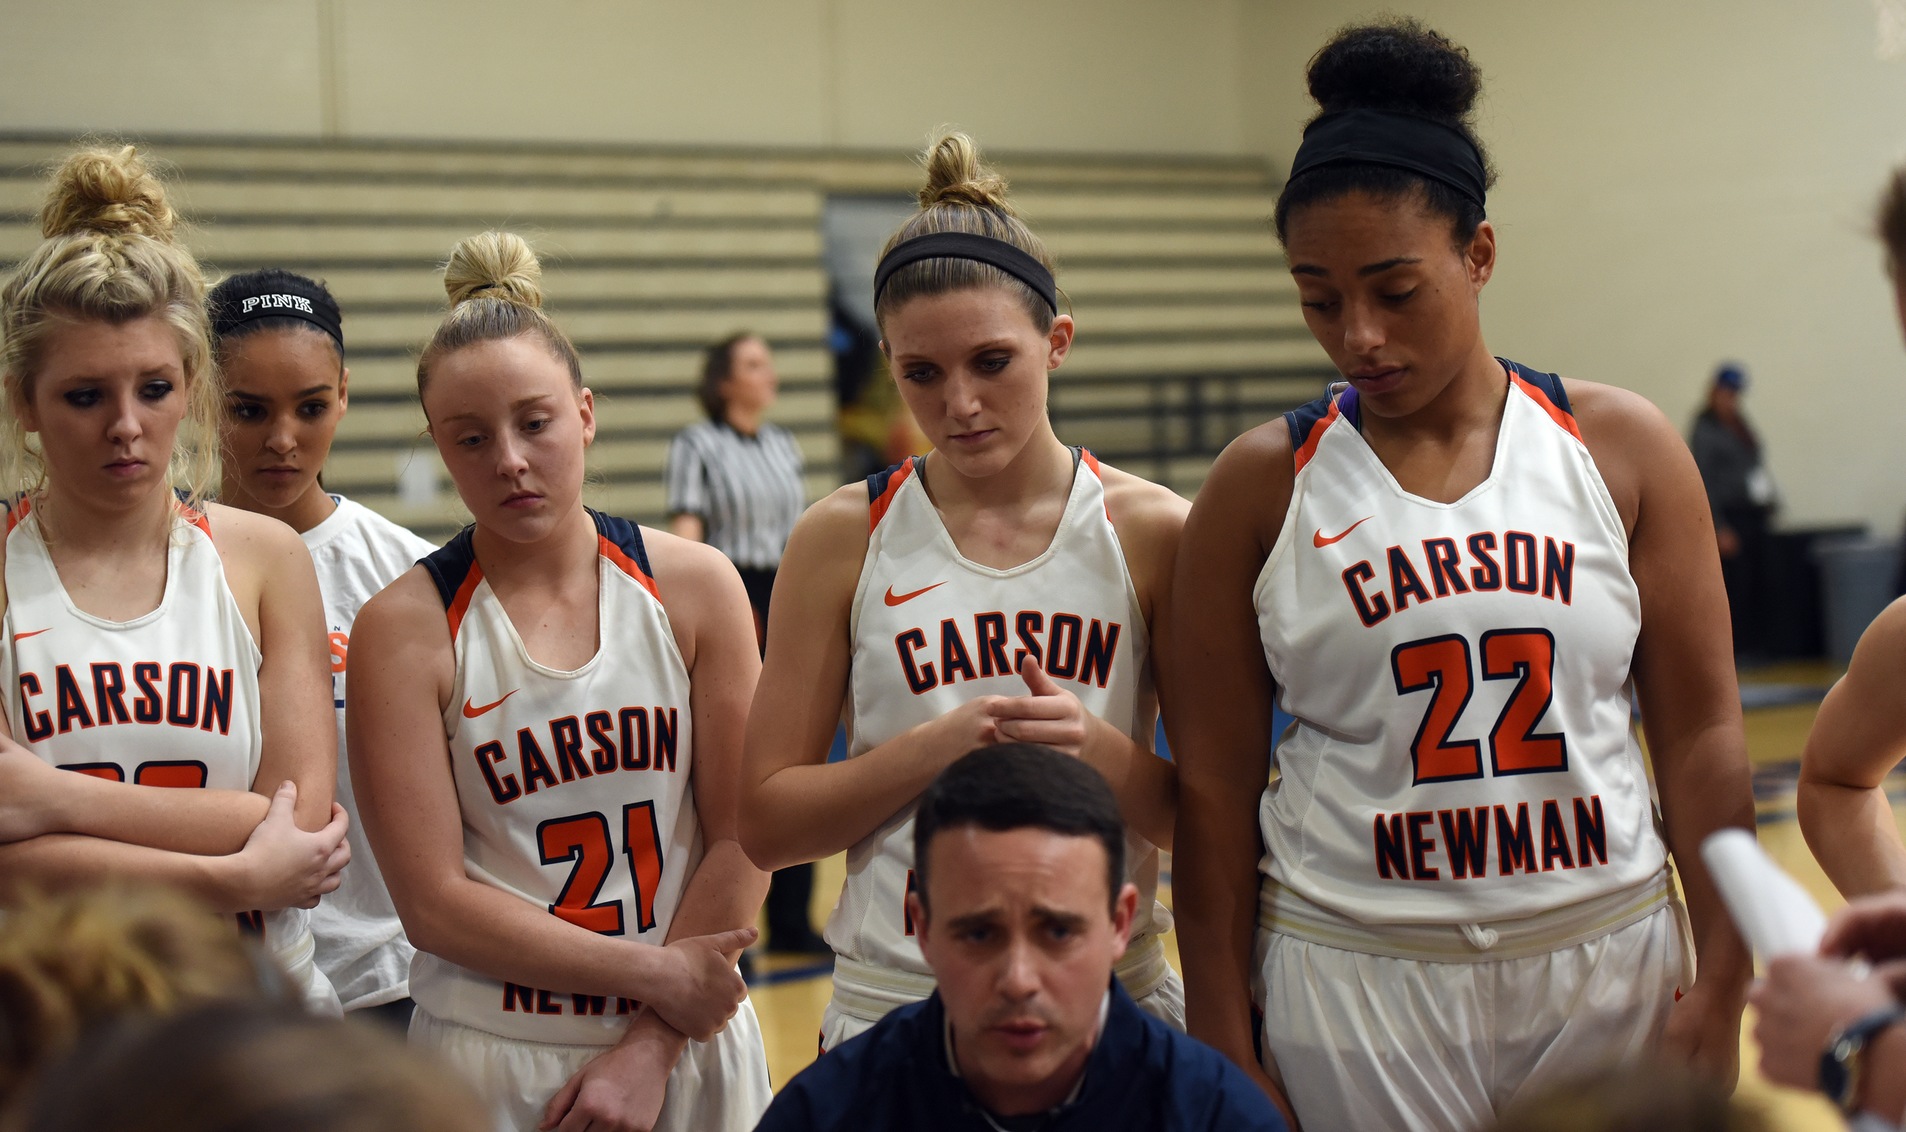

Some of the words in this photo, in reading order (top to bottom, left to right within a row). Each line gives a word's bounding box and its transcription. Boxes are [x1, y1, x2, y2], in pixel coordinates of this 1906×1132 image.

[242, 294, 313, 314] PINK
[1341, 530, 1575, 628] CARSON
[895, 611, 1121, 695] CARSON
[20, 661, 234, 743] CARSON
[1391, 627, 1568, 787] 22
[474, 706, 678, 805] CARSON
[536, 799, 664, 935] 21
[1374, 795, 1608, 881] NEWMAN
